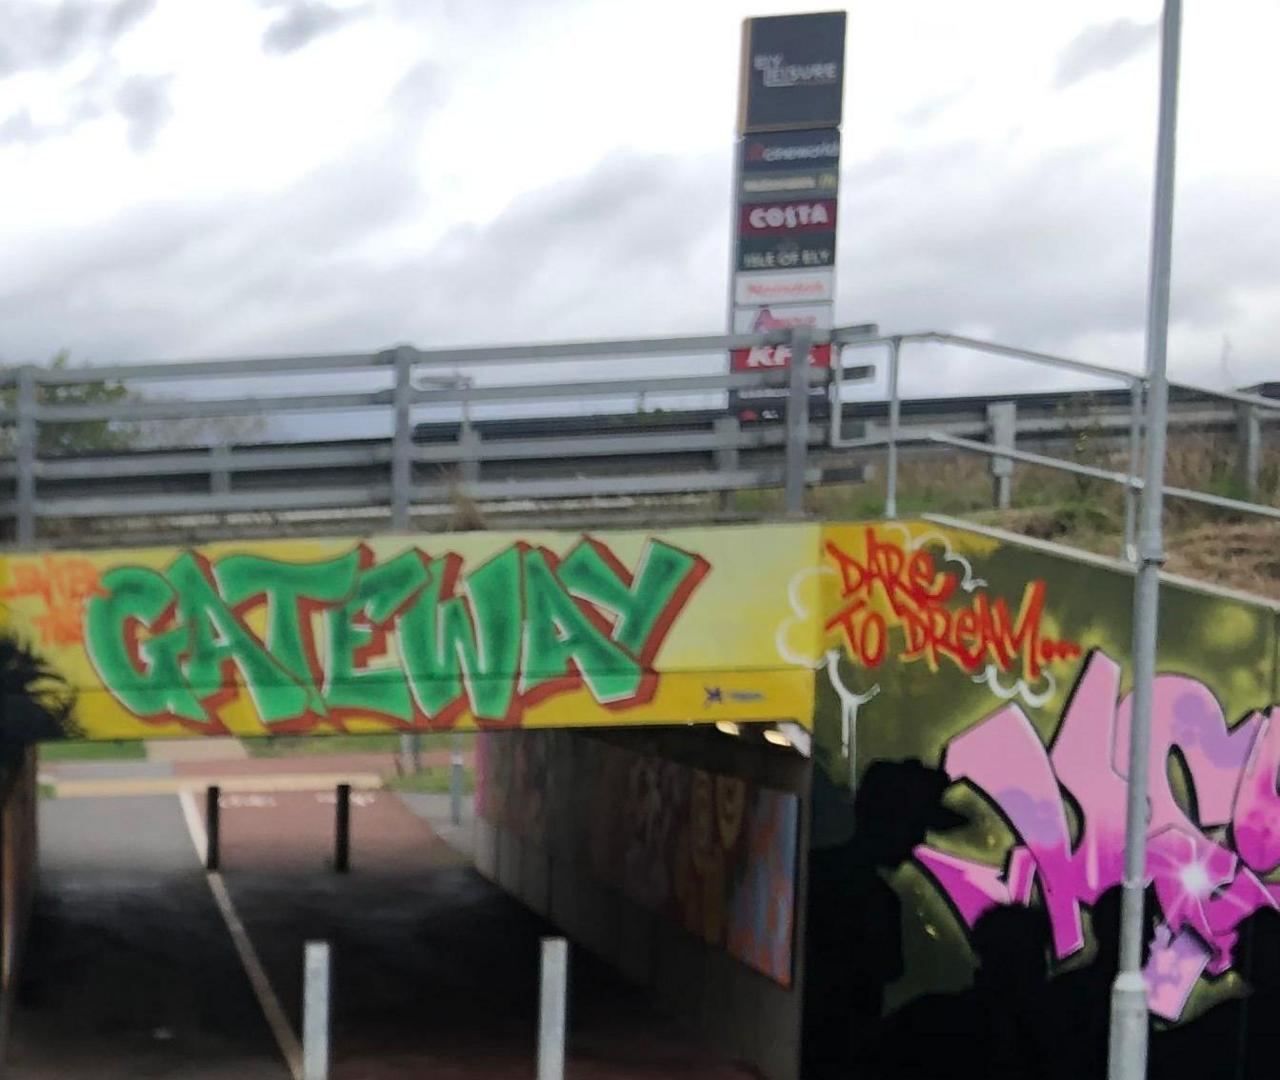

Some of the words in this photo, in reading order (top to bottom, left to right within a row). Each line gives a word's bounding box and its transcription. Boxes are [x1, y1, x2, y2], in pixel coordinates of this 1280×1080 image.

[749, 203, 829, 229] COSTA
[778, 250, 801, 266] OF
[746, 345, 817, 368] KF
[83, 533, 712, 735] GATEWAY
[825, 600, 887, 669] TO
